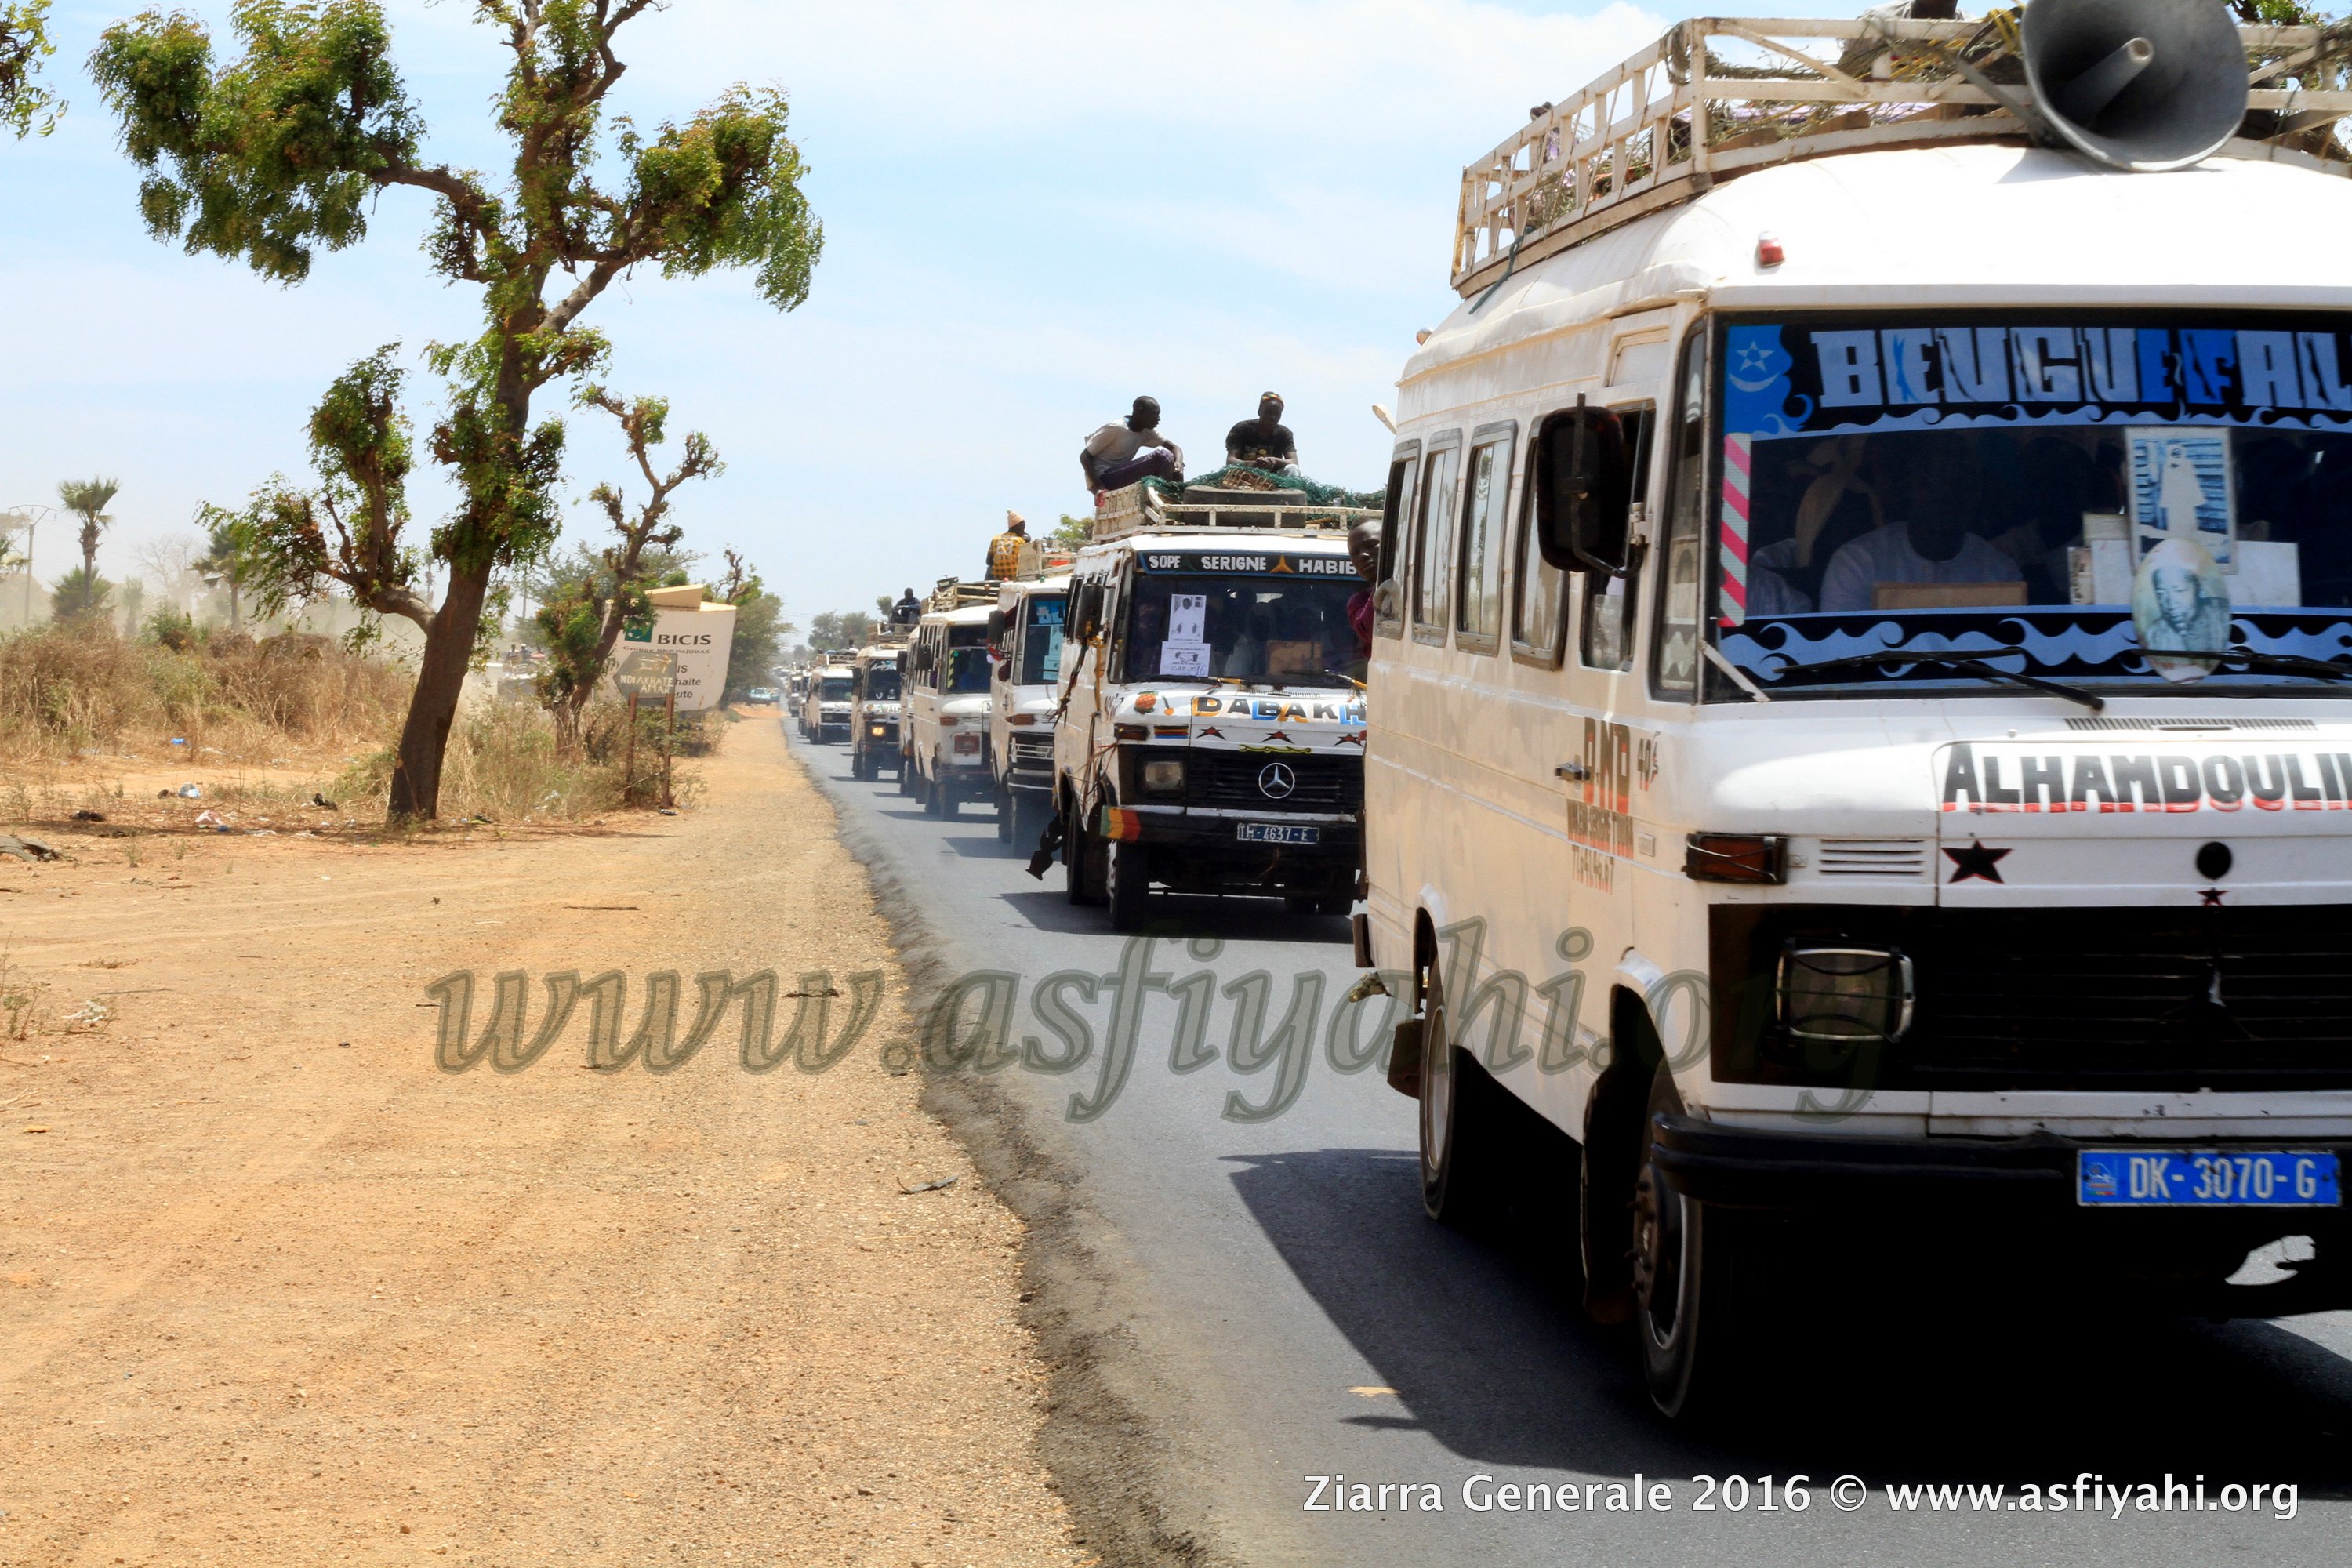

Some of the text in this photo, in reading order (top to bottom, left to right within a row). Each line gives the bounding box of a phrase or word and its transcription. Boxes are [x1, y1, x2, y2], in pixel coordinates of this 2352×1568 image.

[1149, 556, 1358, 575] SOPE SERIGNE HABIB
[658, 634, 712, 645] BICIS
[677, 665, 688, 673] IS
[1192, 696, 1367, 726] DABAKH
[2129, 1157, 2317, 1199] DK-3070-G
